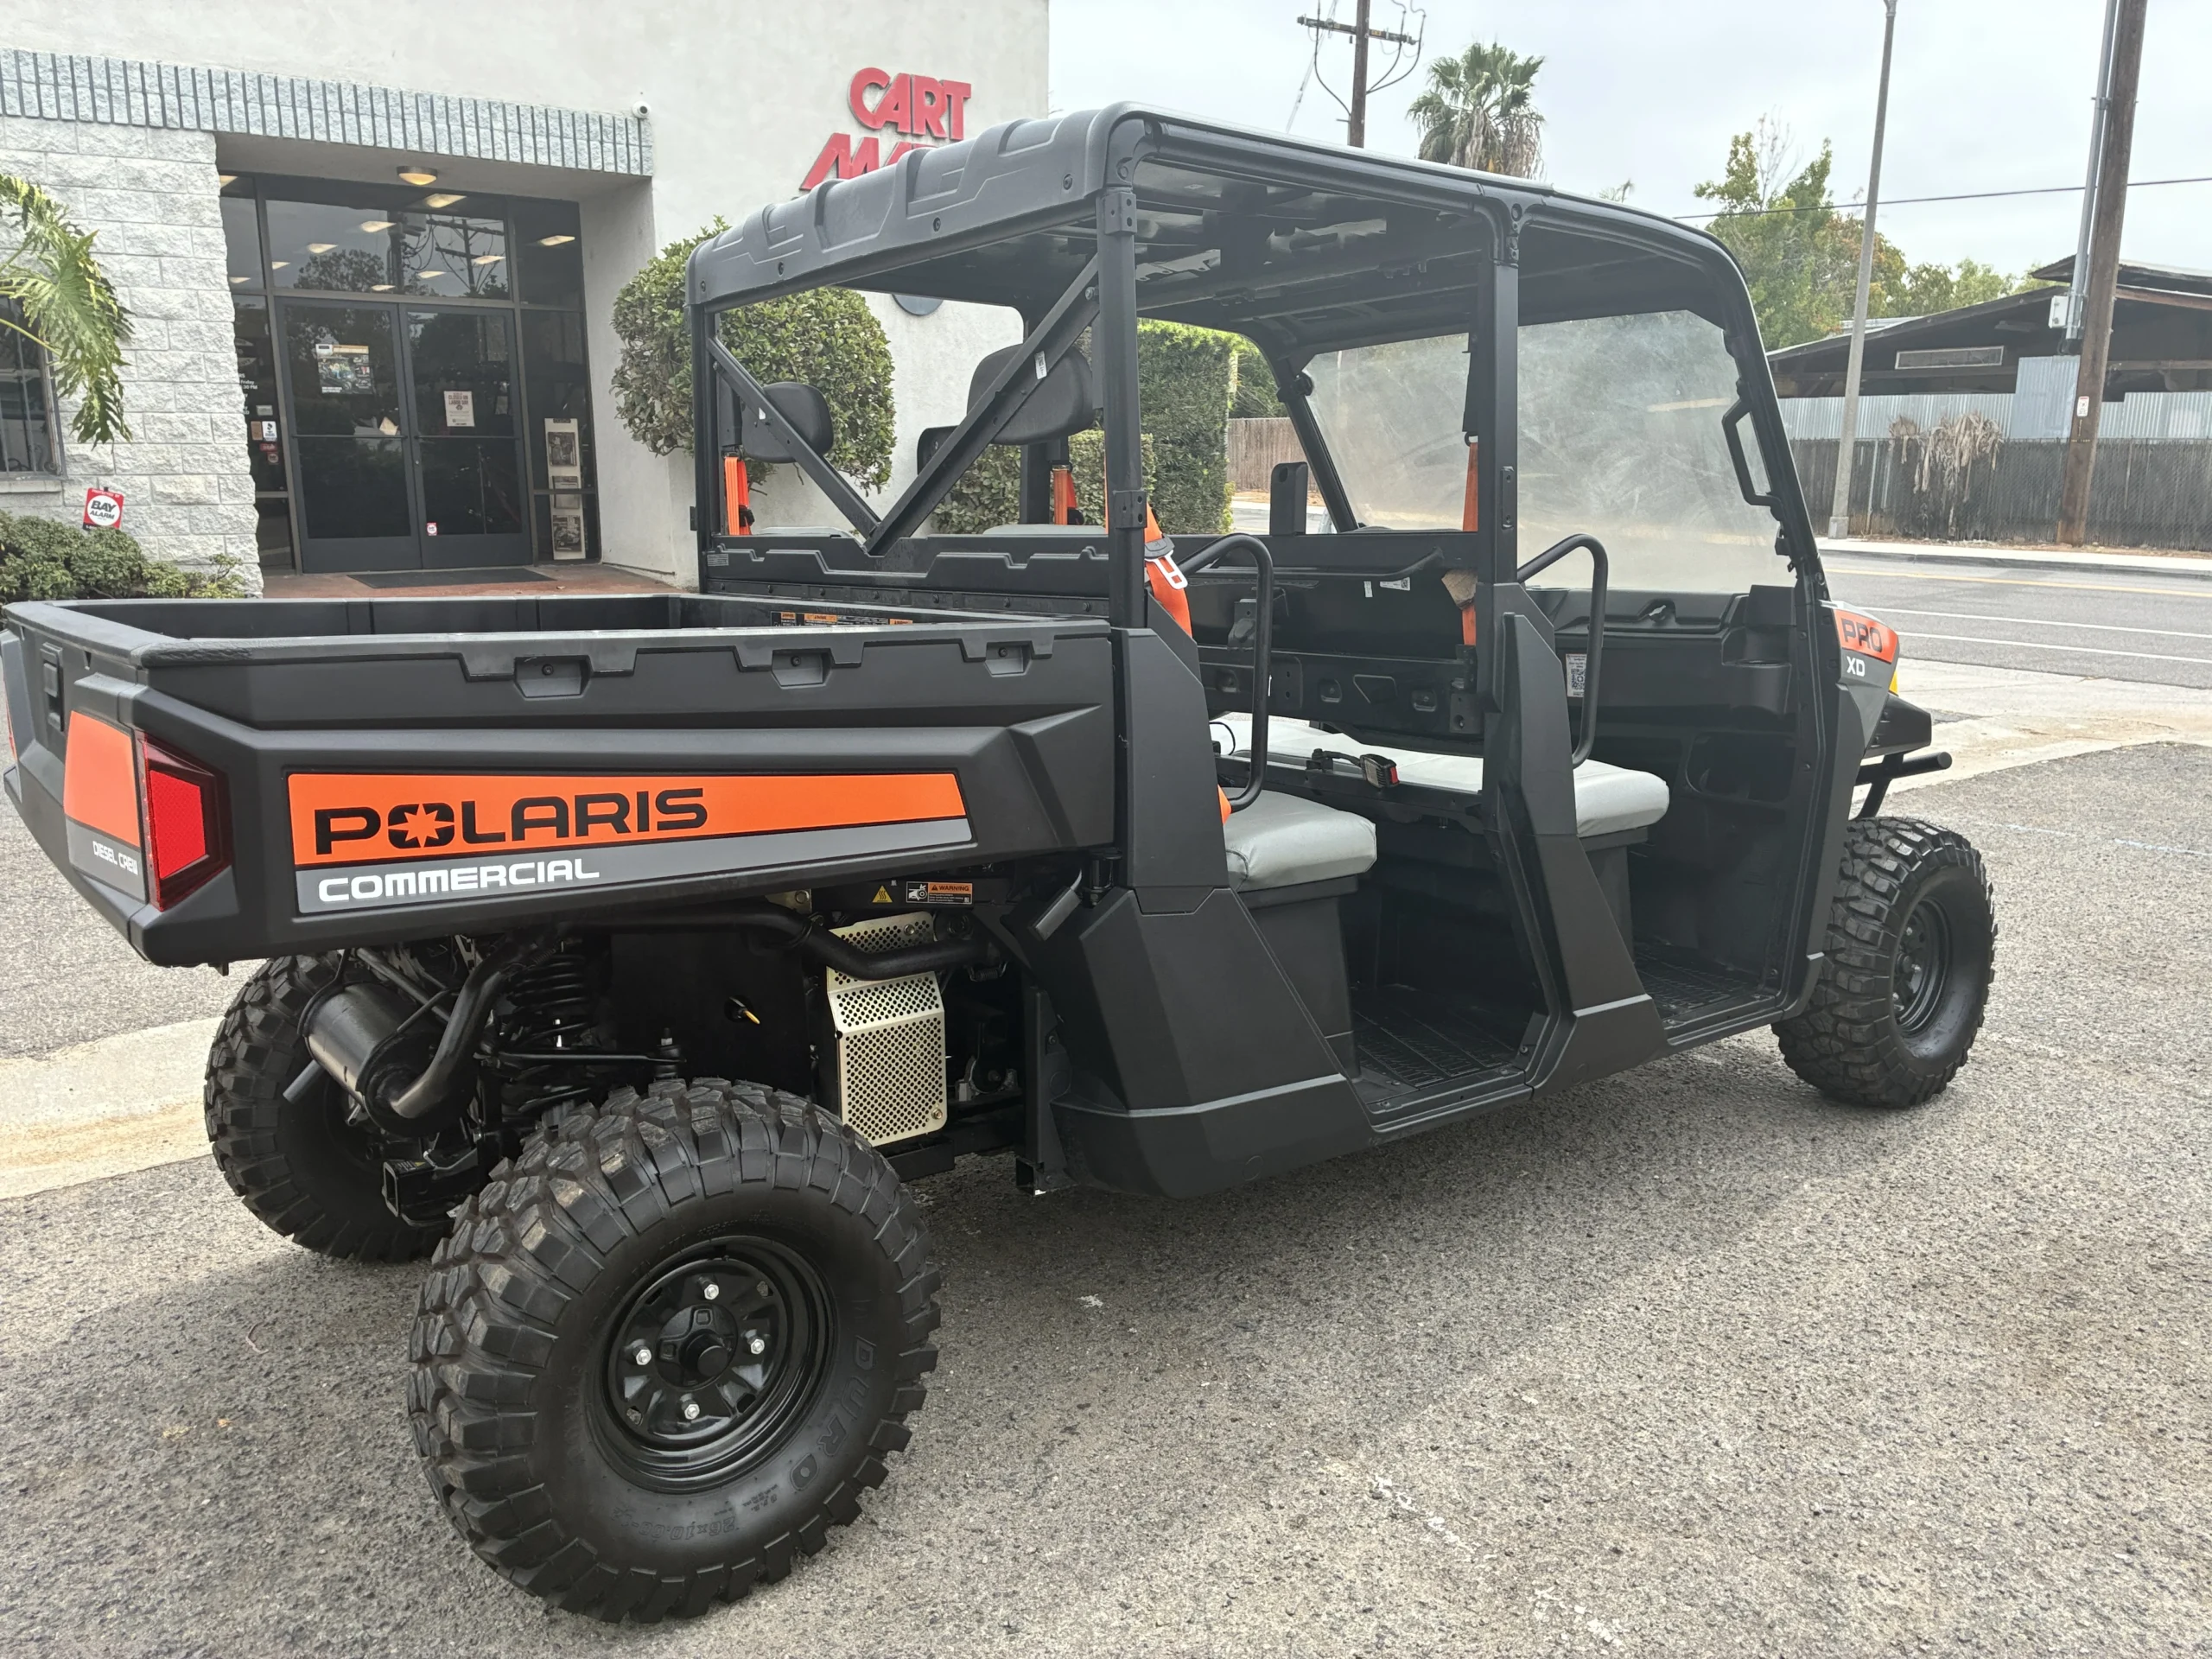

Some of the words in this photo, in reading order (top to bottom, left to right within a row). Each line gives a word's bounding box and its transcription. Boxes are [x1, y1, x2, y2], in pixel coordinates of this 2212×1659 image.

[848, 67, 971, 141] CART
[90, 510, 115, 519] ALARM
[91, 500, 117, 512] BAY
[1841, 618, 1883, 653] PRO
[1847, 656, 1865, 677] XD
[314, 787, 709, 855] POLARIS
[92, 841, 118, 865] DIESEL
[318, 858, 601, 902] COMMERCIAL
[790, 1335, 877, 1491] DURO
